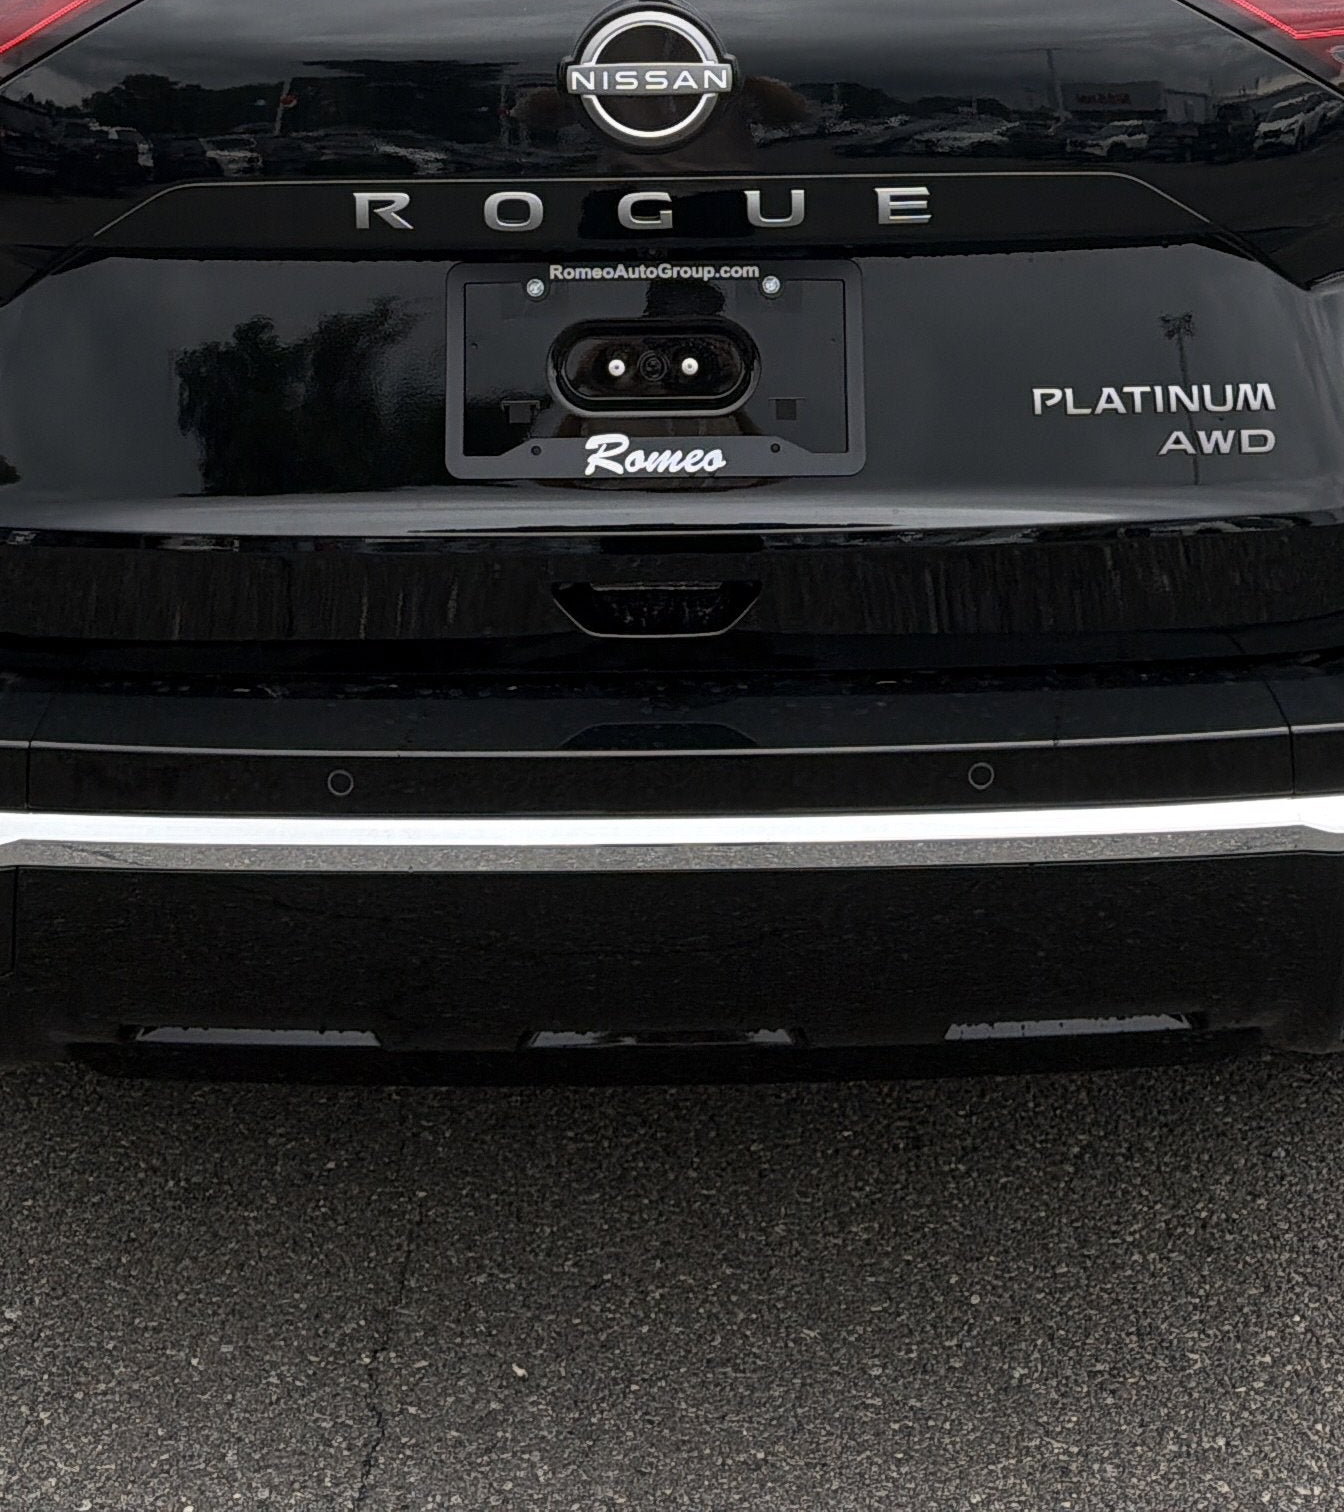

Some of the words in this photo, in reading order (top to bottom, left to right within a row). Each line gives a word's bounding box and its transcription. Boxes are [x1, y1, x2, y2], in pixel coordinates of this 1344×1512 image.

[571, 68, 729, 91] NISSAN
[352, 186, 932, 233] ROGUE
[548, 264, 760, 283] RomeoAutoGroup.com
[1032, 382, 1277, 416] PLATINUM
[583, 432, 727, 477] Romeo
[1158, 428, 1277, 455] AWD
